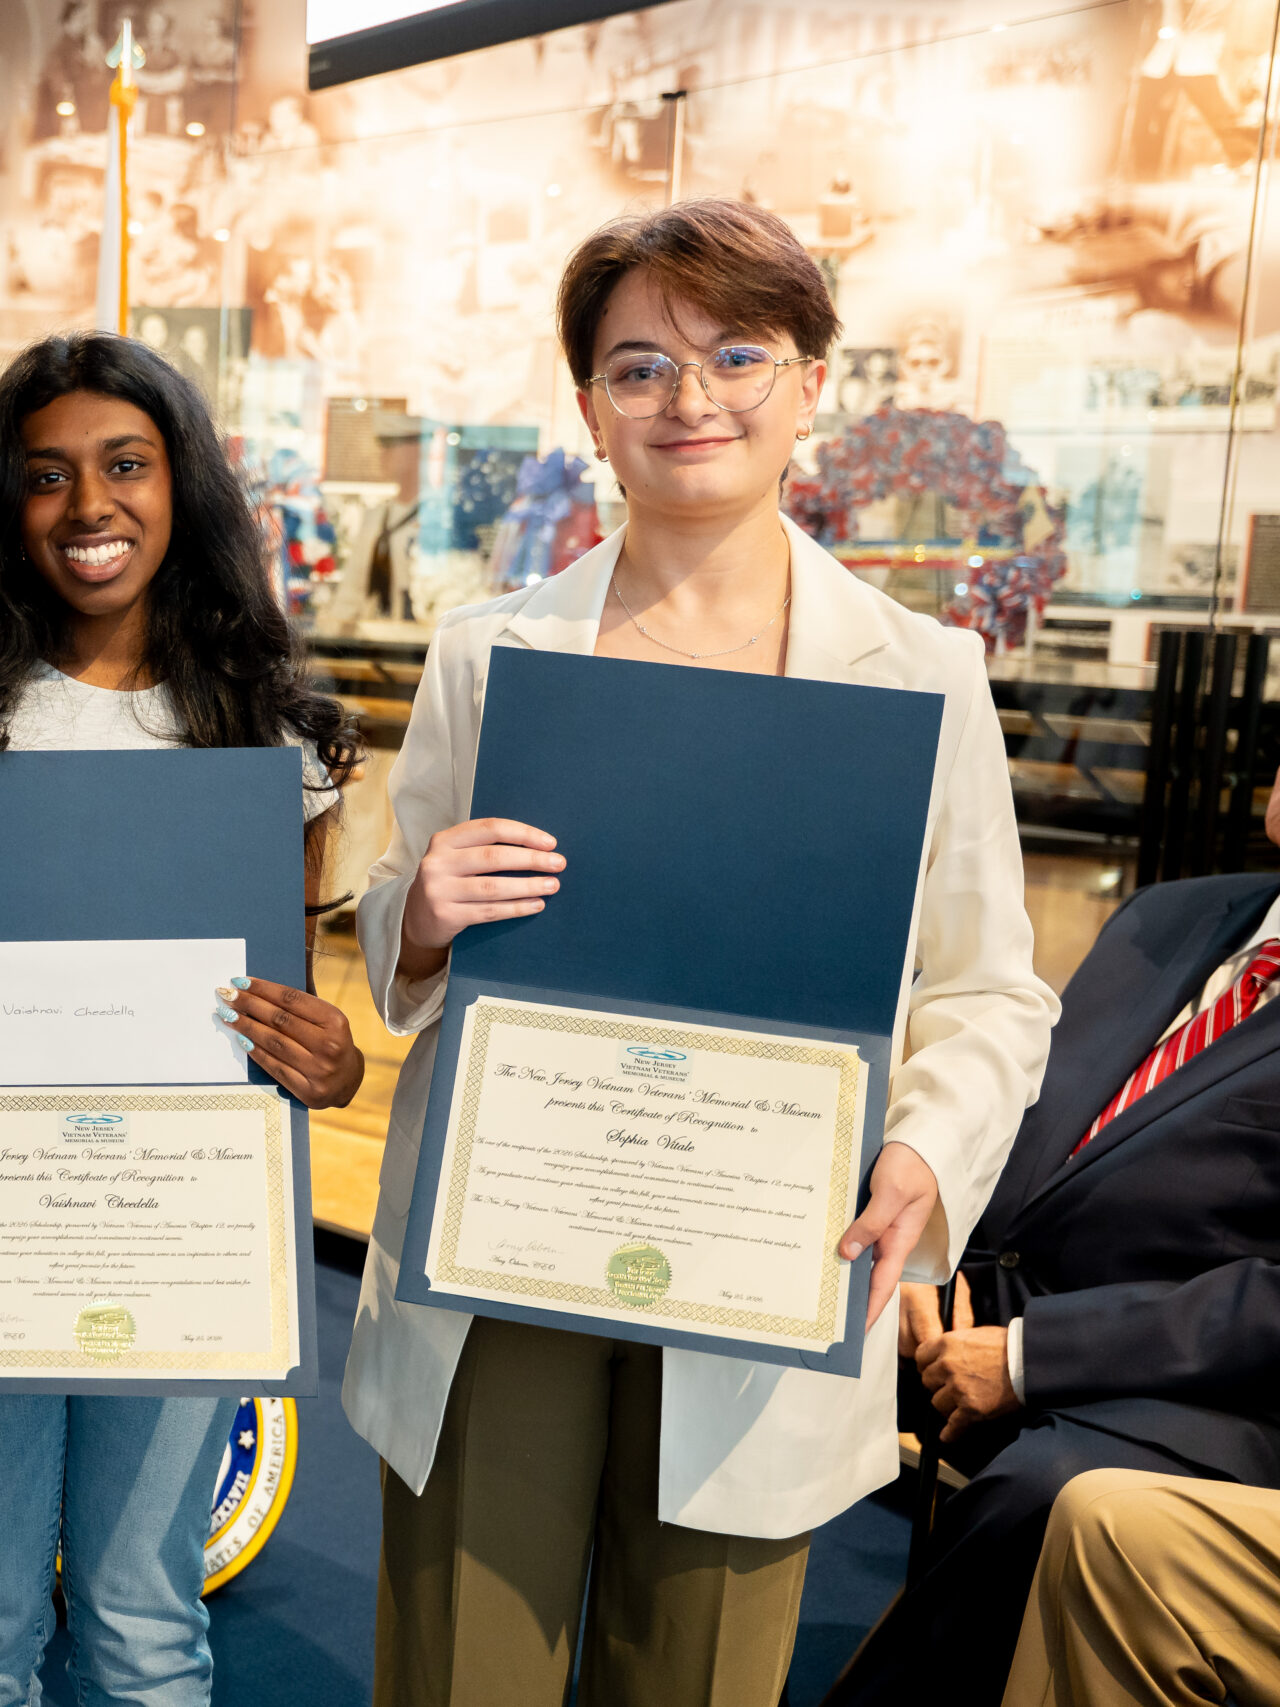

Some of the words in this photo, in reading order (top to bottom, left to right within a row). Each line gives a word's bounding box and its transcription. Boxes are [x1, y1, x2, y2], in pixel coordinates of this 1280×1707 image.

[2, 1004, 63, 1017] Vaishnavi
[74, 1004, 135, 1018] Cheedella
[620, 1062, 651, 1073] VIETNAM
[634, 1057, 650, 1065] NEW
[652, 1060, 676, 1069] JERSEY
[622, 1070, 654, 1079] MEMORIAL
[659, 1073, 686, 1083] MUSEUM
[494, 1063, 517, 1077] The
[518, 1066, 546, 1082] New
[545, 1072, 583, 1092] Jersey
[586, 1076, 634, 1094] Vietnam
[638, 1082, 692, 1101] Veterans'
[692, 1090, 752, 1110] Memorial
[754, 1099, 770, 1112] &
[771, 1100, 822, 1119] Museum
[544, 1097, 586, 1110] presents
[587, 1101, 605, 1112] this
[609, 1099, 663, 1120] Certificate
[664, 1112, 678, 1124] of
[676, 1110, 745, 1132] Recognition
[606, 1128, 649, 1148] Sophia
[656, 1134, 695, 1152] Vitale
[33, 1147, 78, 1161] Vietnam
[133, 1147, 188, 1161] Memorial
[190, 1148, 206, 1160] &
[208, 1147, 254, 1160] Museum
[36, 1171, 52, 1181] this
[57, 1168, 107, 1185] Certificate
[109, 1171, 122, 1185] of
[121, 1169, 185, 1187] Recognition
[630, 1172, 644, 1180] and
[647, 1160, 674, 1171] Vietnam
[711, 1168, 740, 1180] America
[744, 1173, 768, 1185] Chapter
[790, 1183, 814, 1194] proudly
[39, 1193, 97, 1208] Vaishnavi
[105, 1194, 160, 1208] Cheedella
[248, 1506, 264, 1528] OF
[264, 1414, 285, 1496] AMERICA
